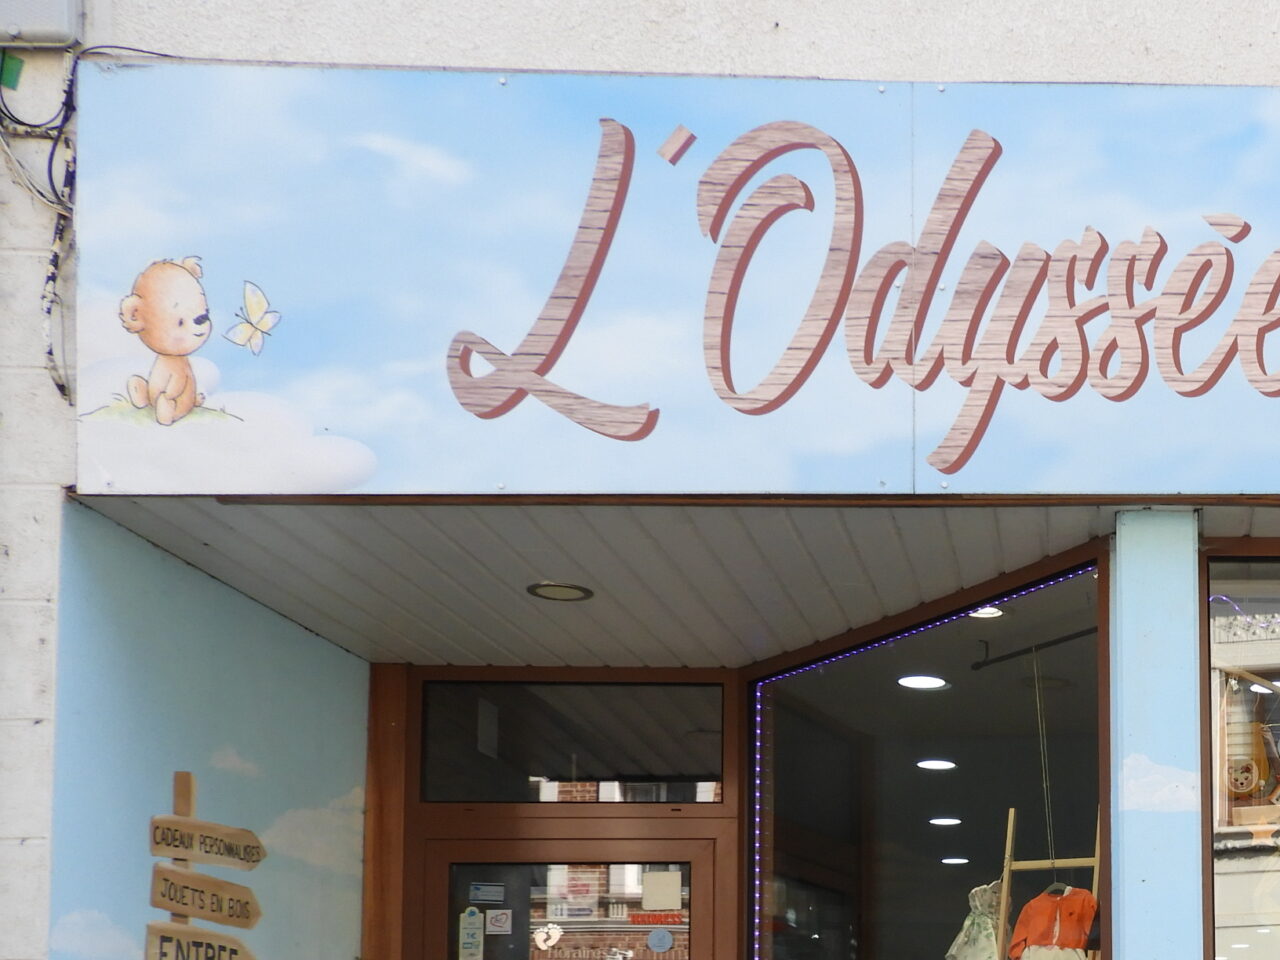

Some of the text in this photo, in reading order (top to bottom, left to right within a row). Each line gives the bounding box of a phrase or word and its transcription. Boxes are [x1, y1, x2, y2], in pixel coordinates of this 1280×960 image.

[153, 826, 194, 849] CADEAUX
[161, 878, 250, 919] JOUETS EN BOIS
